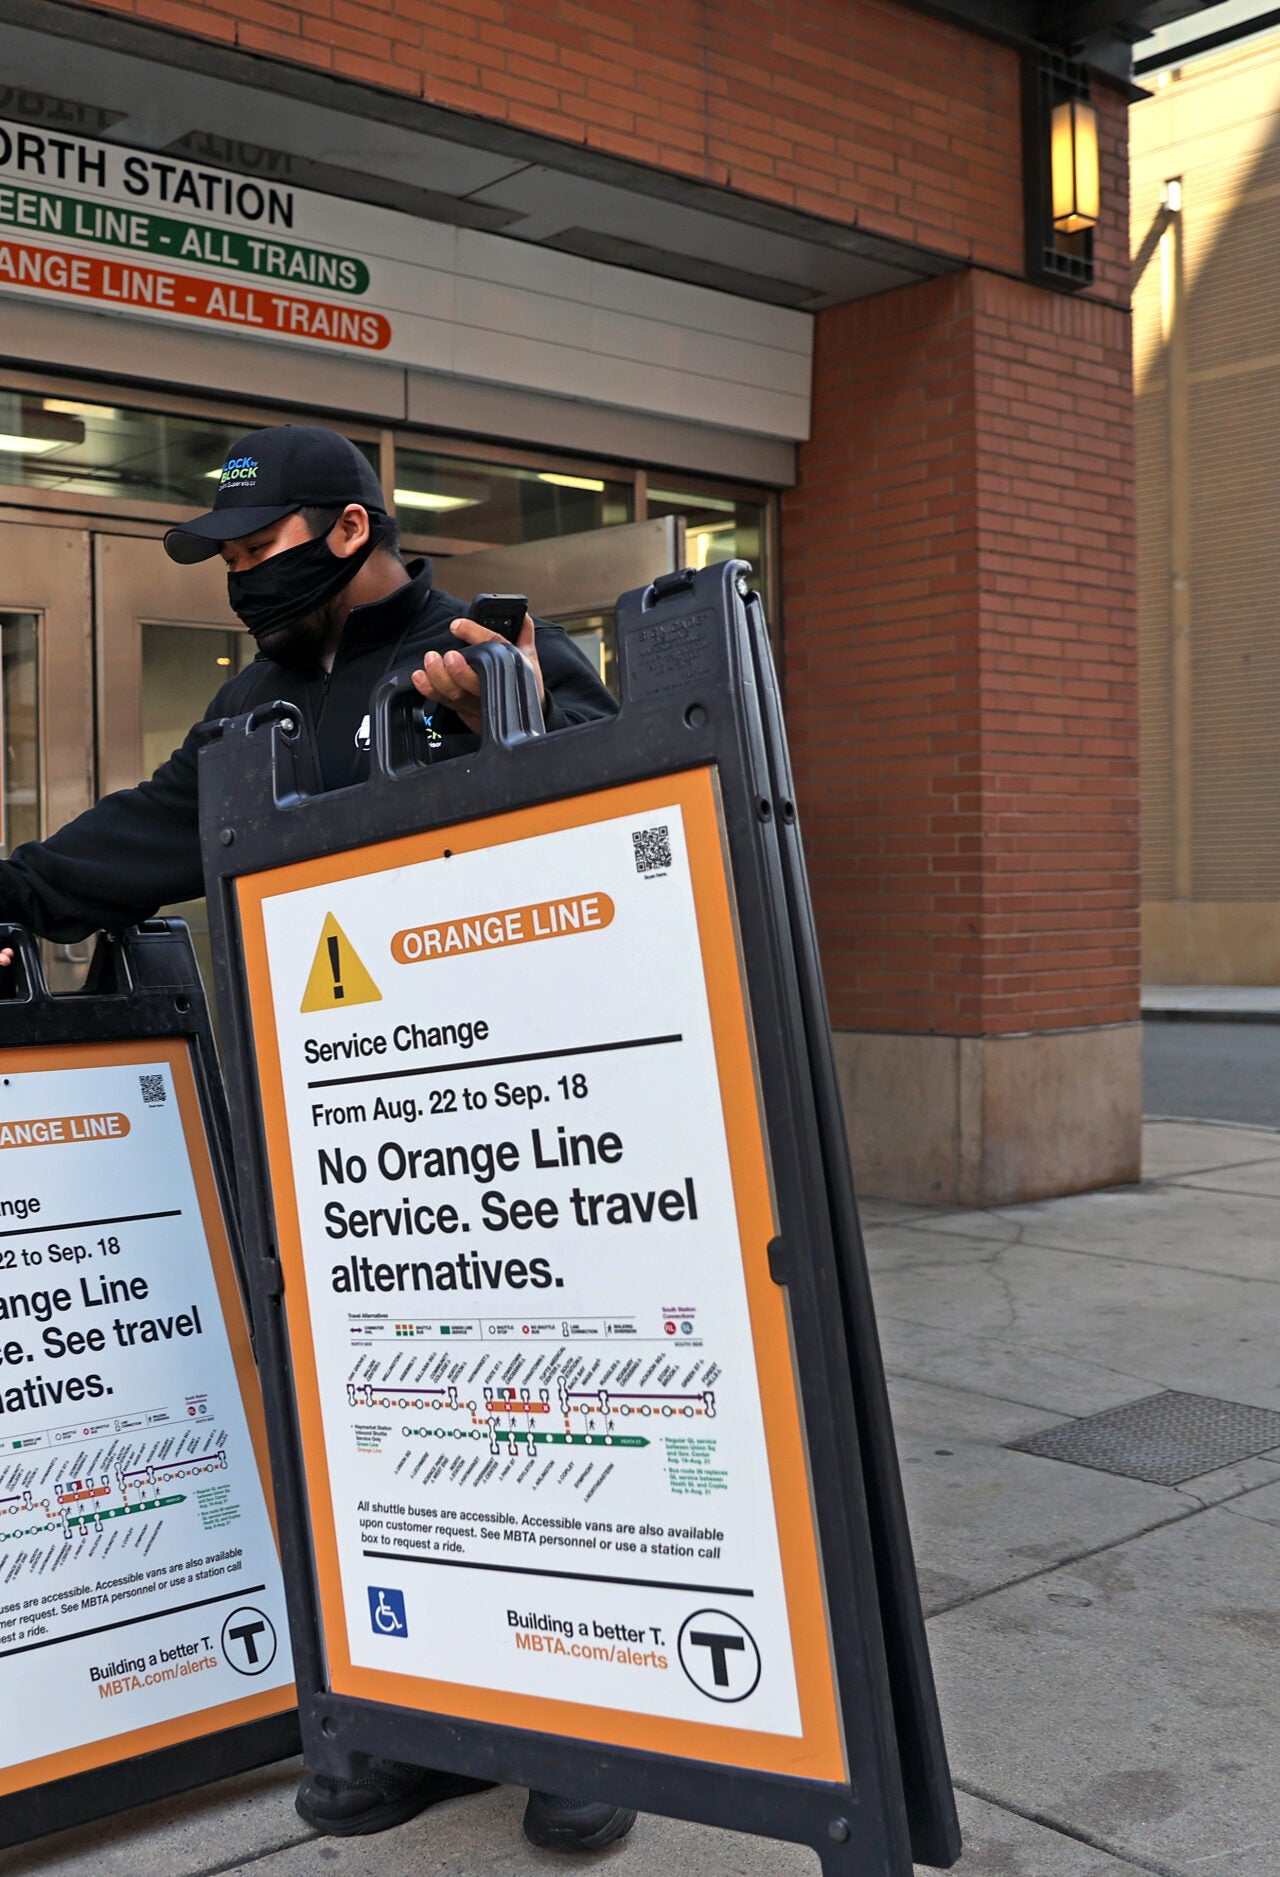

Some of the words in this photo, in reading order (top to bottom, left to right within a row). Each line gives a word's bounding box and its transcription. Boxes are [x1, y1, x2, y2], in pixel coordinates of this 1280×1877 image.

[123, 156, 293, 228] STATION
[75, 204, 149, 247] LINE
[180, 228, 239, 265] ALL
[247, 240, 356, 289] TRAINS
[102, 266, 175, 307] LINE
[206, 287, 263, 323] ALL
[271, 298, 378, 345] TRAINS
[220, 467, 259, 483] BLOCK
[403, 912, 523, 958] ORANGE
[532, 897, 601, 935] LINE
[304, 1033, 387, 1064] Service
[393, 1020, 488, 1051] Change
[311, 1104, 366, 1126] From
[373, 1097, 423, 1123] Aug.
[429, 1089, 457, 1114] 22
[462, 1088, 487, 1110] to
[494, 1082, 549, 1109] Sep.
[557, 1073, 588, 1100] 18
[70, 1116, 121, 1138] LINE
[318, 1147, 366, 1185] No
[378, 1141, 519, 1183] Orange
[531, 1126, 623, 1168] Line
[324, 1197, 470, 1239] Service.
[481, 1190, 558, 1231] See
[569, 1177, 697, 1226] travel
[21, 1249, 42, 1266] to
[47, 1244, 92, 1264] Sep.
[97, 1236, 120, 1256] 18
[331, 1250, 564, 1293] alternatives.
[79, 1274, 148, 1307] Line
[42, 1326, 105, 1358] See
[112, 1305, 202, 1346] travel
[357, 1500, 369, 1511] All
[372, 1502, 405, 1514] shuttle
[408, 1505, 437, 1517] buses
[440, 1510, 457, 1519] are
[459, 1511, 518, 1524] accessible.
[521, 1514, 582, 1530] Accessible
[585, 1522, 612, 1532] vans
[616, 1524, 635, 1534] are
[638, 1523, 664, 1536] also
[667, 1526, 724, 1541] available
[359, 1519, 383, 1529] upon
[386, 1521, 432, 1533] customer
[435, 1526, 477, 1537] request.
[480, 1527, 500, 1540] See
[503, 1529, 536, 1543] MBTA
[539, 1535, 596, 1548] personnel
[599, 1540, 612, 1549] or
[615, 1541, 636, 1552] use
[640, 1543, 647, 1553] a
[651, 1543, 694, 1557] station
[698, 1546, 720, 1559] call
[361, 1532, 378, 1543] box
[381, 1534, 390, 1545] to
[393, 1537, 430, 1549] request
[433, 1541, 439, 1550] a
[442, 1540, 465, 1552] ride.
[19, 1607, 58, 1624] request.
[60, 1603, 79, 1614] See
[81, 1594, 109, 1609] MBTA
[111, 1581, 156, 1603] personnel
[157, 1581, 168, 1589] or
[169, 1577, 186, 1587] use
[187, 1574, 193, 1582] a
[195, 1567, 225, 1580] station
[226, 1560, 242, 1572] call
[23, 1598, 38, 1608] are
[41, 1585, 93, 1604] accessible.
[95, 1572, 144, 1591] Accessible
[145, 1567, 167, 1578] vans
[168, 1563, 183, 1573] are
[185, 1558, 203, 1569] also
[205, 1547, 243, 1564] available
[18, 1631, 24, 1639] a
[27, 1625, 48, 1637] ride.
[507, 1609, 573, 1638] Building
[578, 1623, 588, 1636] a
[592, 1620, 645, 1643] better
[649, 1627, 665, 1646] T.
[89, 1657, 146, 1682] Building
[148, 1654, 157, 1665] a
[159, 1642, 198, 1662] better
[200, 1636, 213, 1650] T.
[515, 1632, 668, 1669] MBTA.com/alerts
[98, 1656, 217, 1698] MBTA.com/alerts
